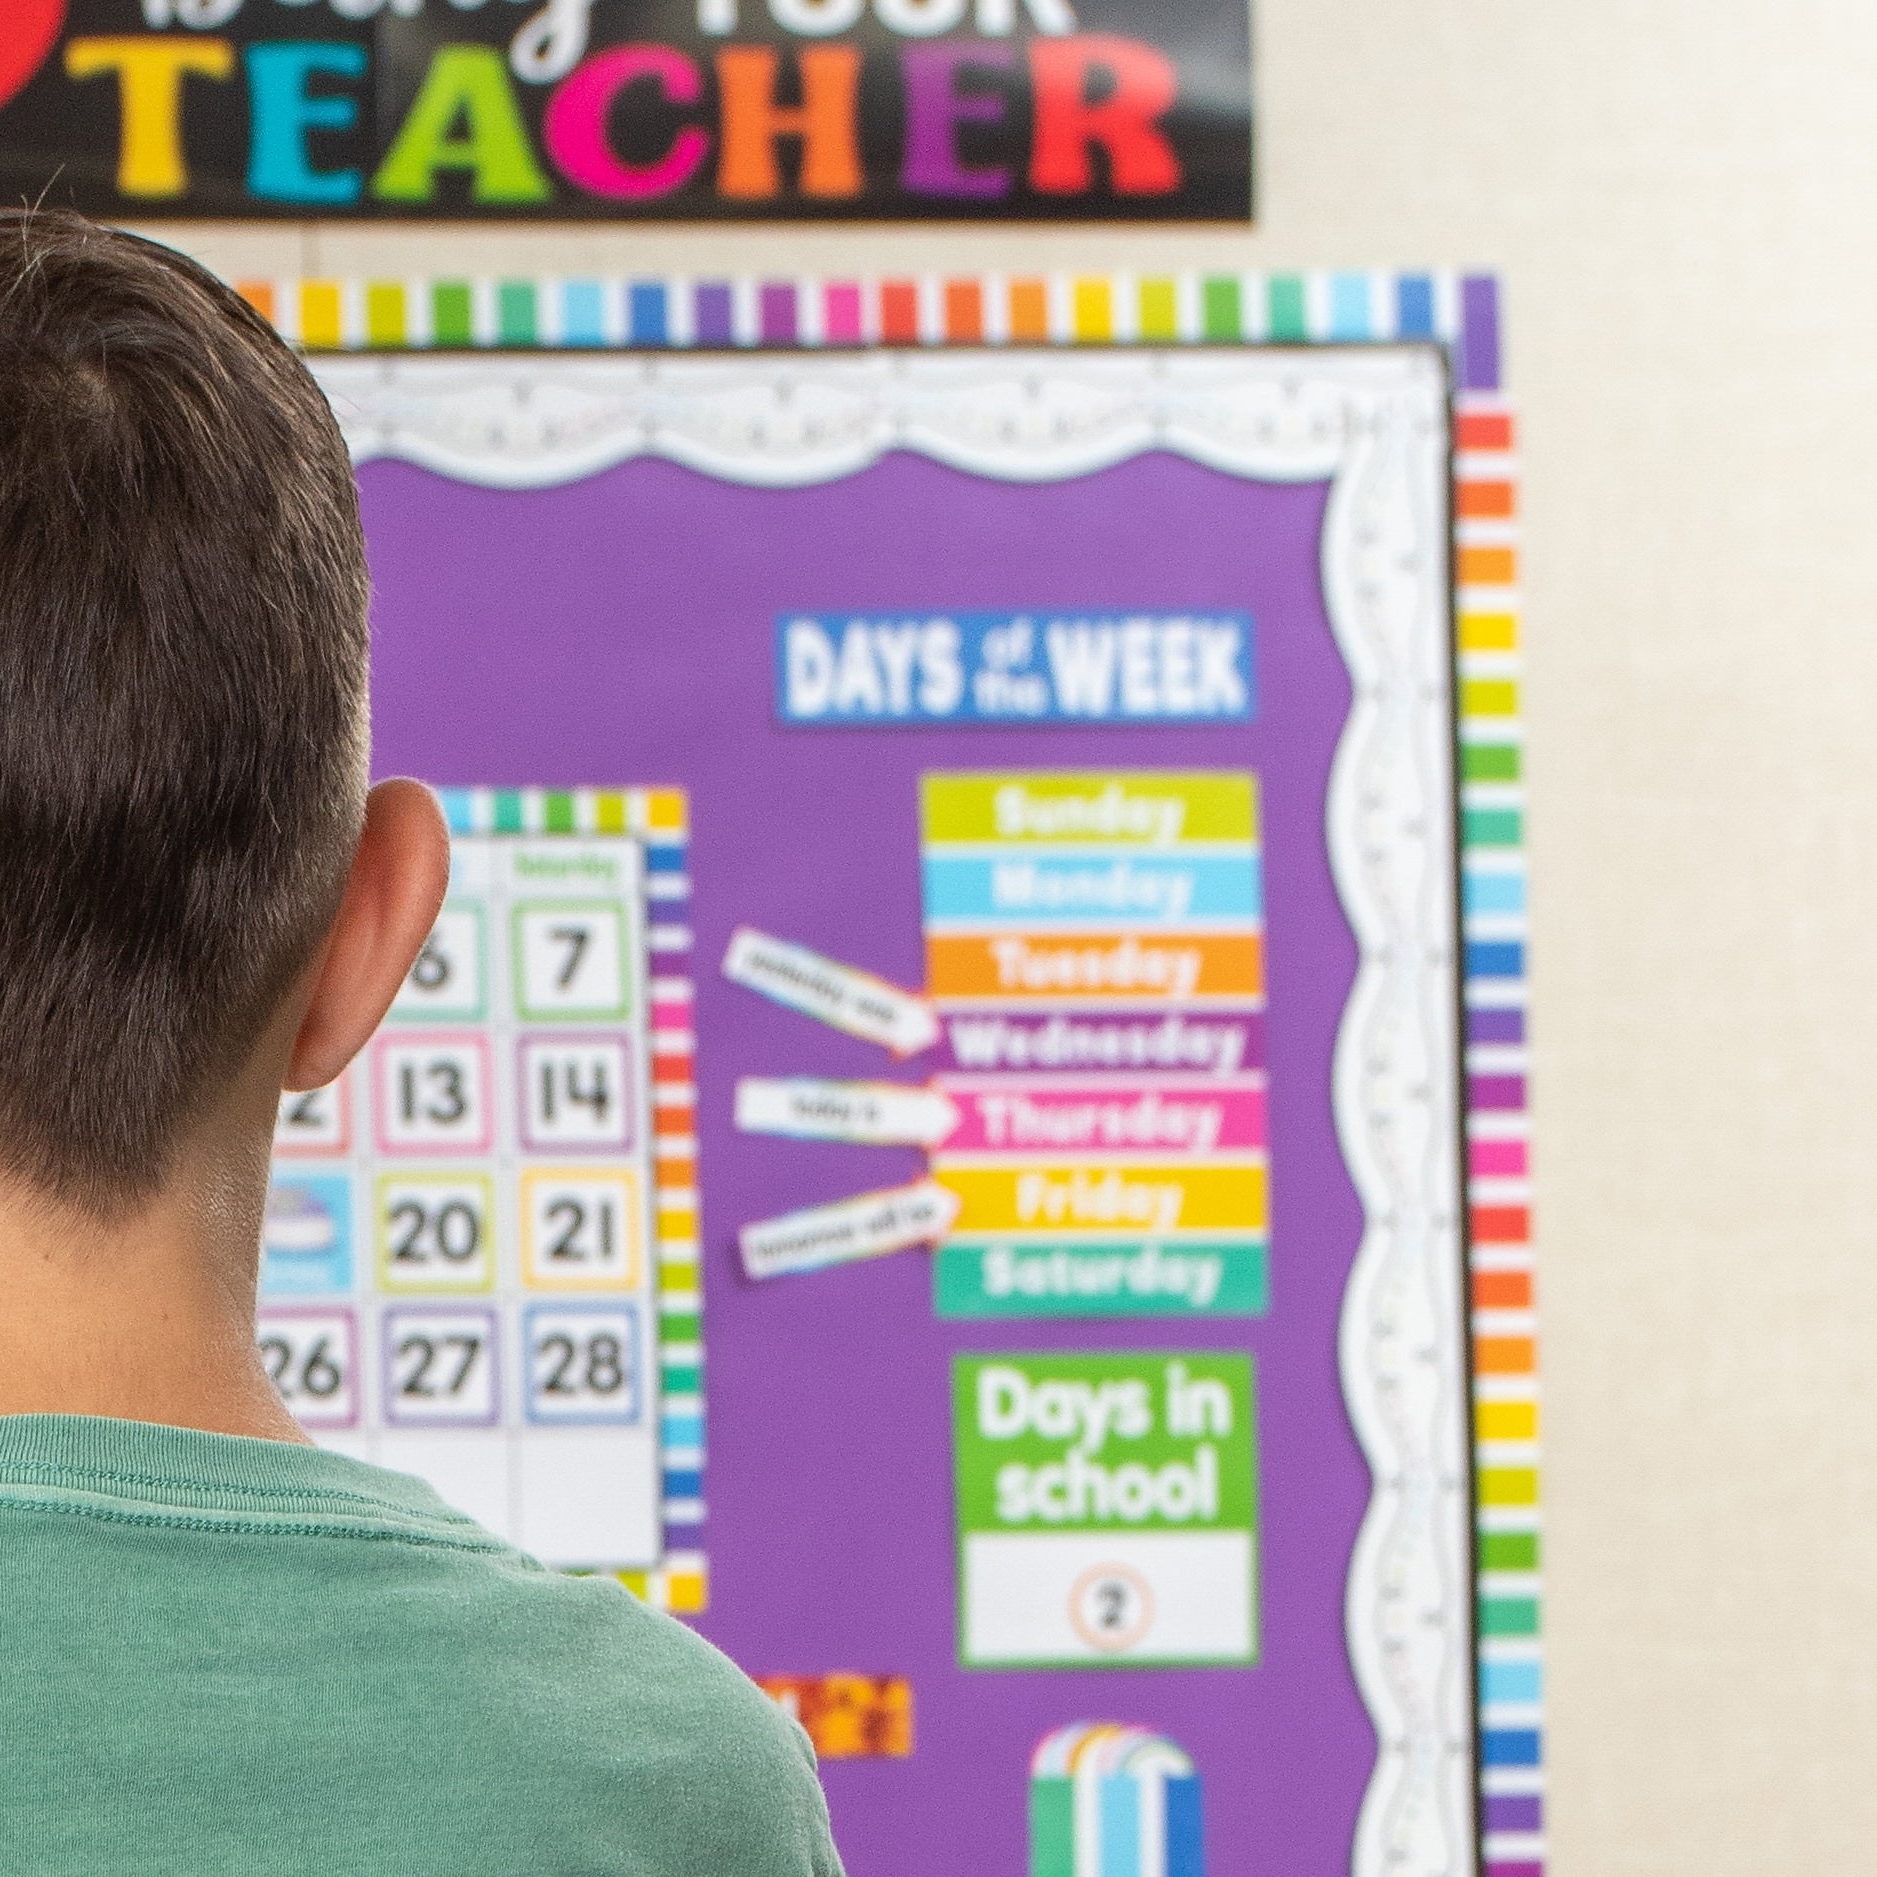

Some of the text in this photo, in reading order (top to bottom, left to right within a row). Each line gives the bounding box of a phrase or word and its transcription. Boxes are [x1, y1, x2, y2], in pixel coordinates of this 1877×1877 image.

[64, 36, 1182, 201] TEACHER
[786, 617, 964, 717] DAYS
[1046, 617, 1246, 718] WEEK
[994, 783, 1186, 850] Sunday
[992, 857, 1192, 922] Monday
[410, 935, 452, 990] 6
[546, 925, 592, 990] 7
[989, 936, 1201, 1002] Tuesday
[950, 1016, 1246, 1079] Wednesday
[398, 1060, 469, 1126] 13
[539, 1060, 610, 1123] 14
[978, 1091, 1220, 1155] Thursday
[387, 1200, 484, 1264] 20
[543, 1200, 614, 1263] 21
[1016, 1167, 1184, 1236] Friday
[981, 1247, 1220, 1308] Saturday
[259, 1334, 342, 1399] 26
[394, 1333, 484, 1397] 27
[536, 1333, 624, 1395] 28
[978, 1360, 1232, 1452] Days in
[996, 1444, 1216, 1521] school
[1096, 1581, 1128, 1630] 2
